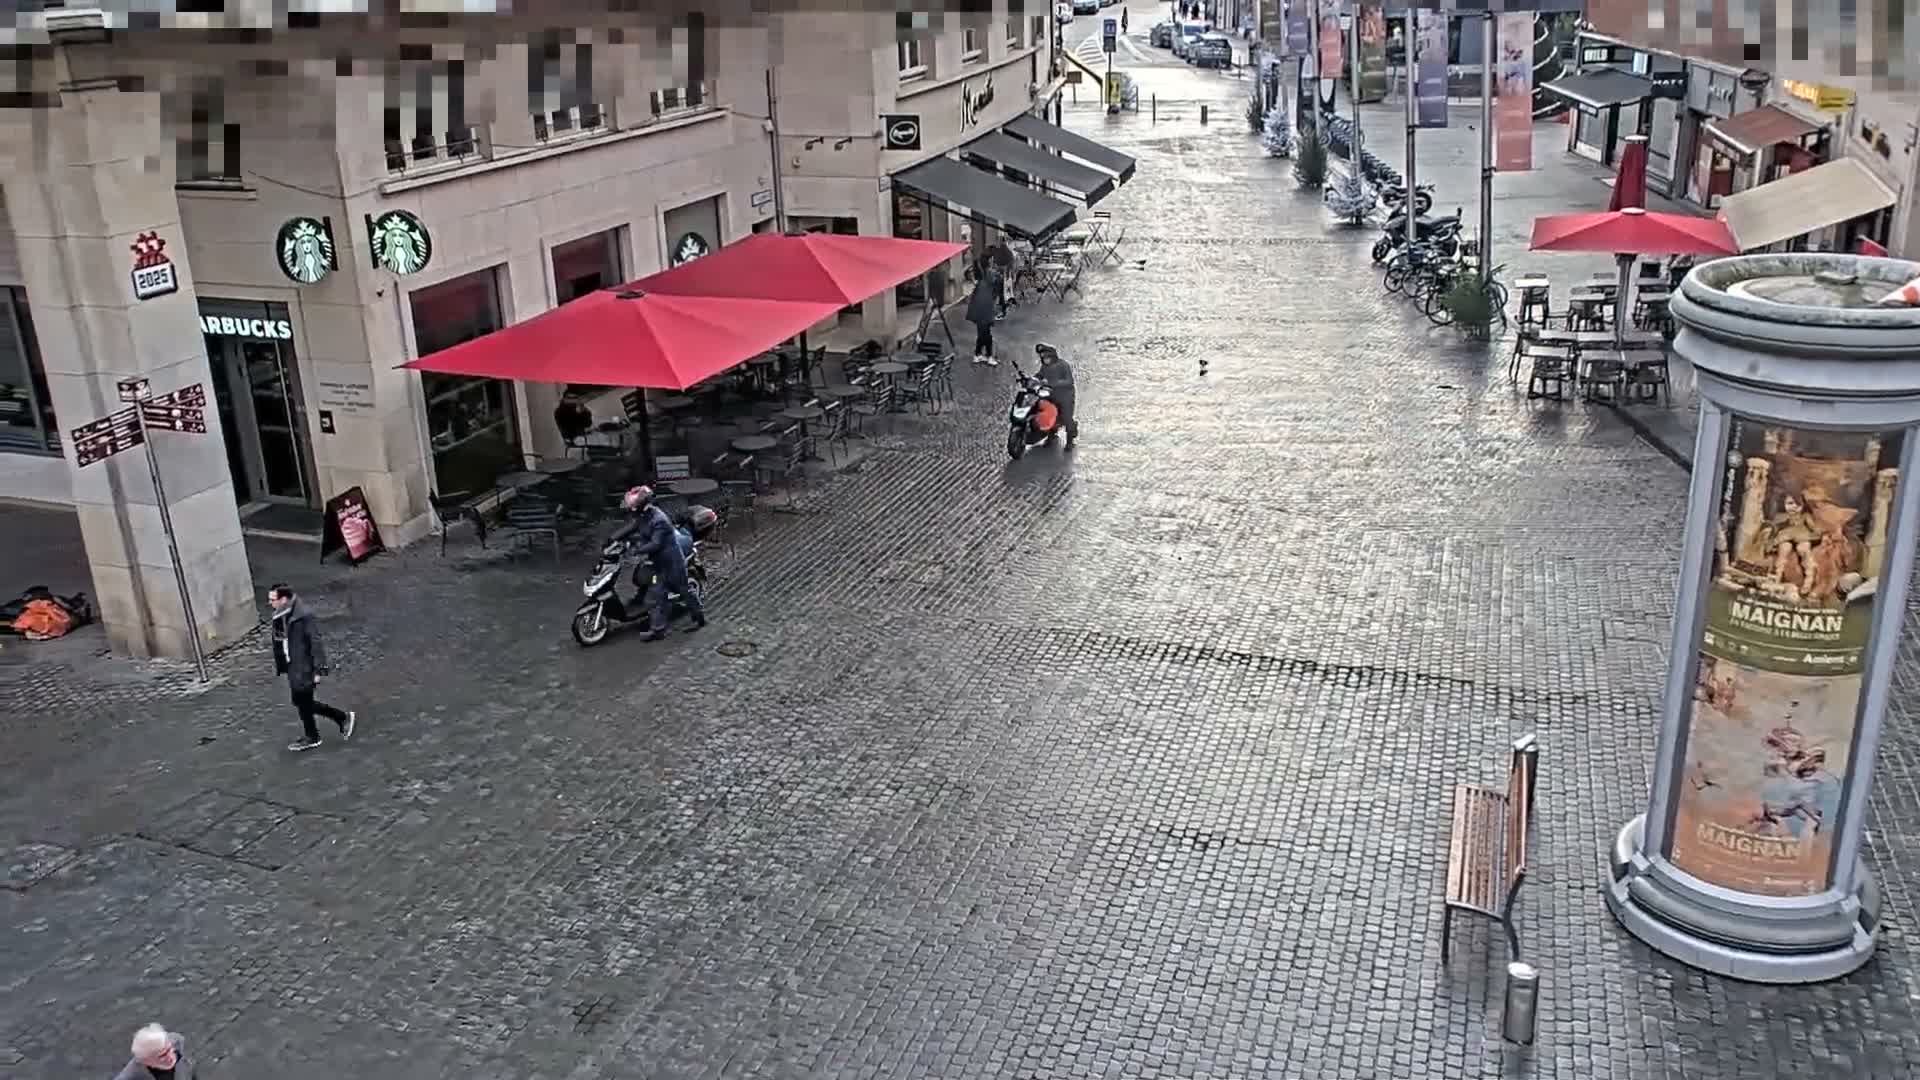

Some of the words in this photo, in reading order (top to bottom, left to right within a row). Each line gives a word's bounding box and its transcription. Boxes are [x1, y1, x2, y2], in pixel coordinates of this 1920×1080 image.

[138, 268, 169, 289] 2025
[199, 315, 292, 340] ARBUCKS
[1731, 601, 1843, 632] MAIGNAN
